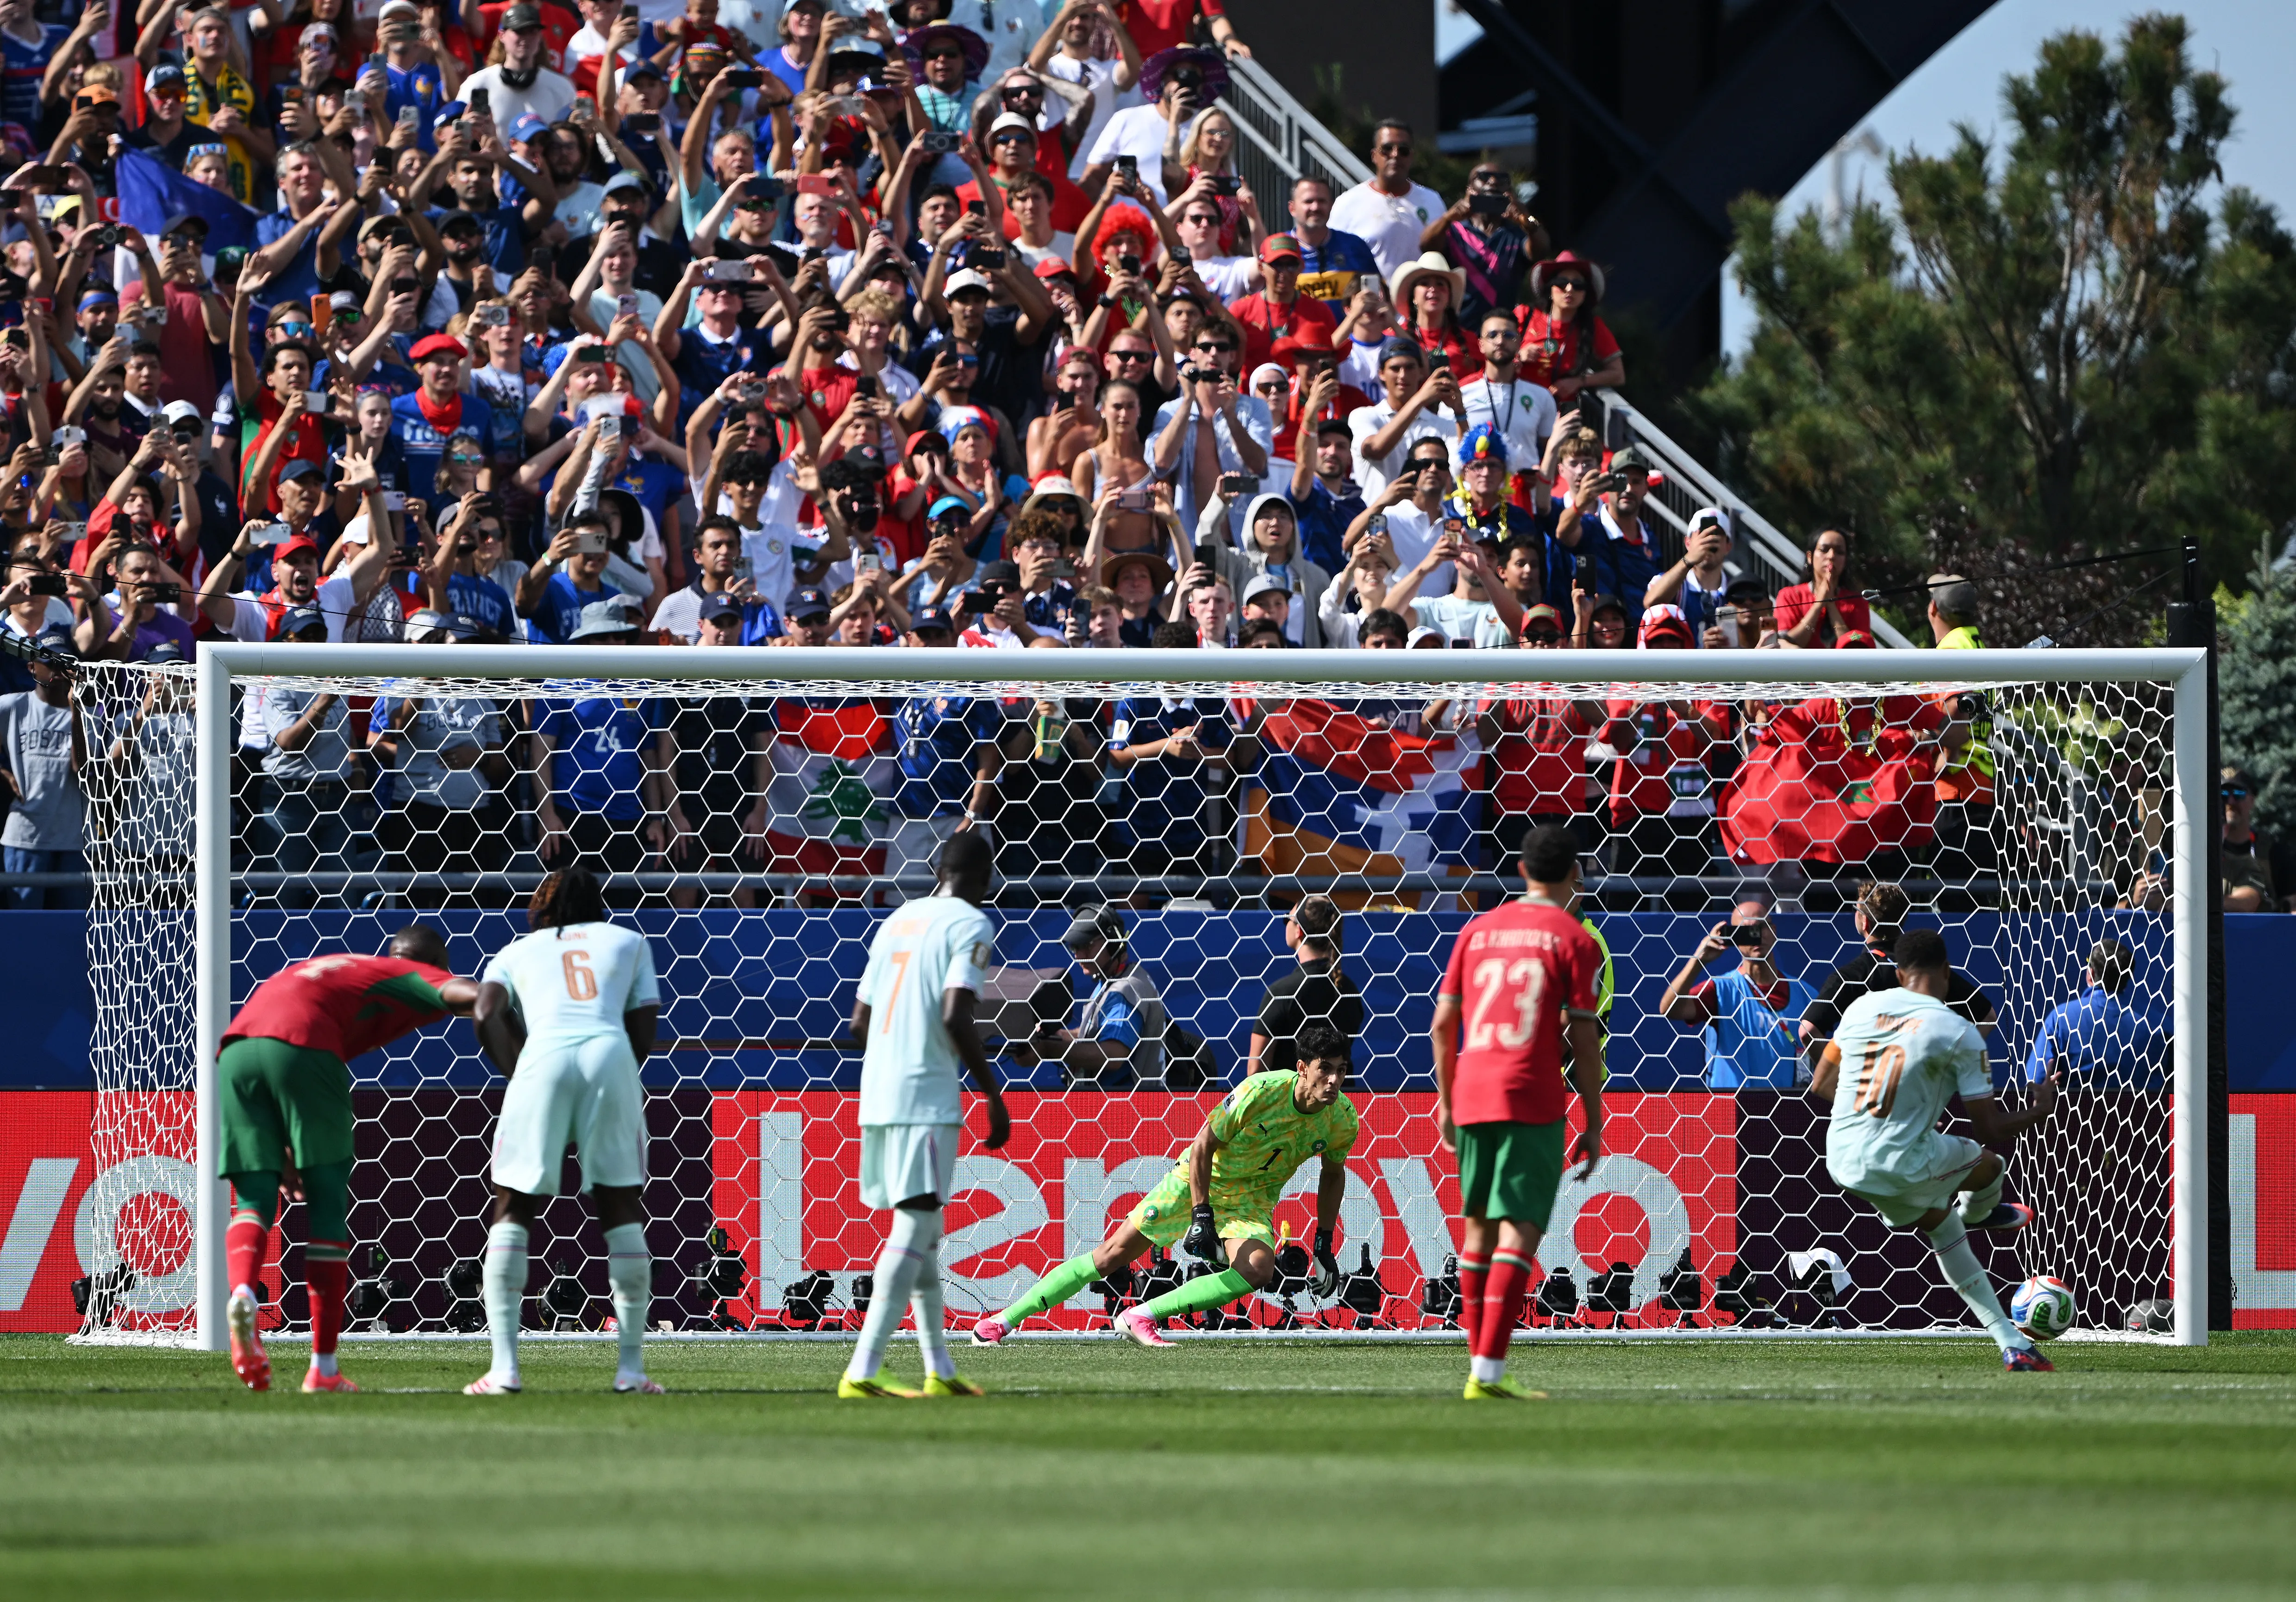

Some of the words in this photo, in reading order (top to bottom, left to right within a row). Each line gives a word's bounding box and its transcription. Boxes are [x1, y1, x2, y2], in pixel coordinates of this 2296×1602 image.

[562, 950, 598, 1001] 6
[882, 951, 913, 1034] 7
[1466, 957, 1545, 1052] 23
[1853, 1041, 1906, 1119] 10
[1257, 1148, 1283, 1170] 1
